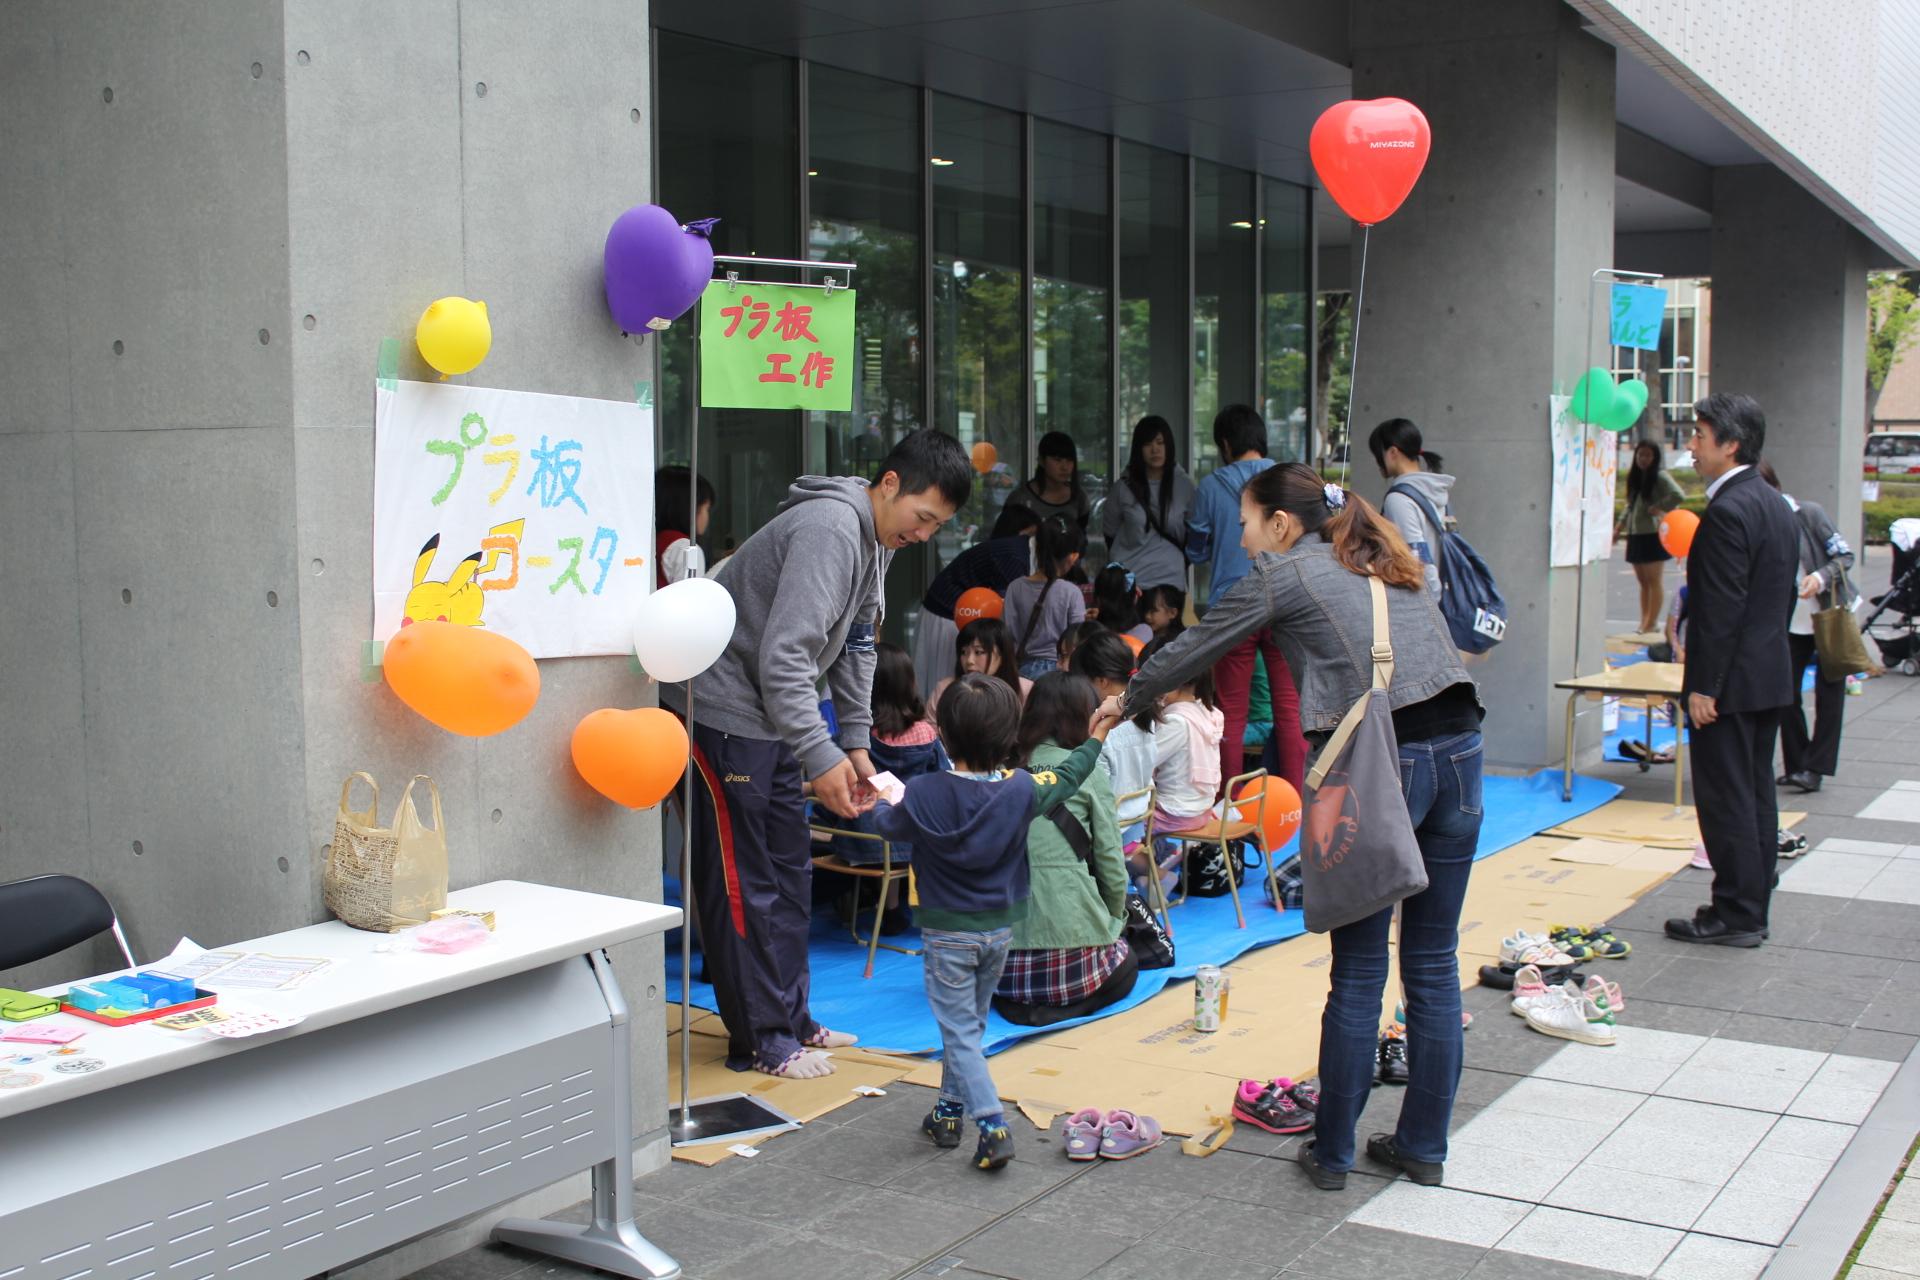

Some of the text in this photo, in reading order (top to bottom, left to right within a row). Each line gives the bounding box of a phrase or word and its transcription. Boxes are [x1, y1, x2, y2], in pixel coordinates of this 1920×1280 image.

[720, 295, 819, 343] プラ板
[758, 351, 835, 389] 工作
[425, 411, 588, 515] プラ板
[480, 526, 645, 595] コースター
[1321, 822, 1359, 871] WORLD
